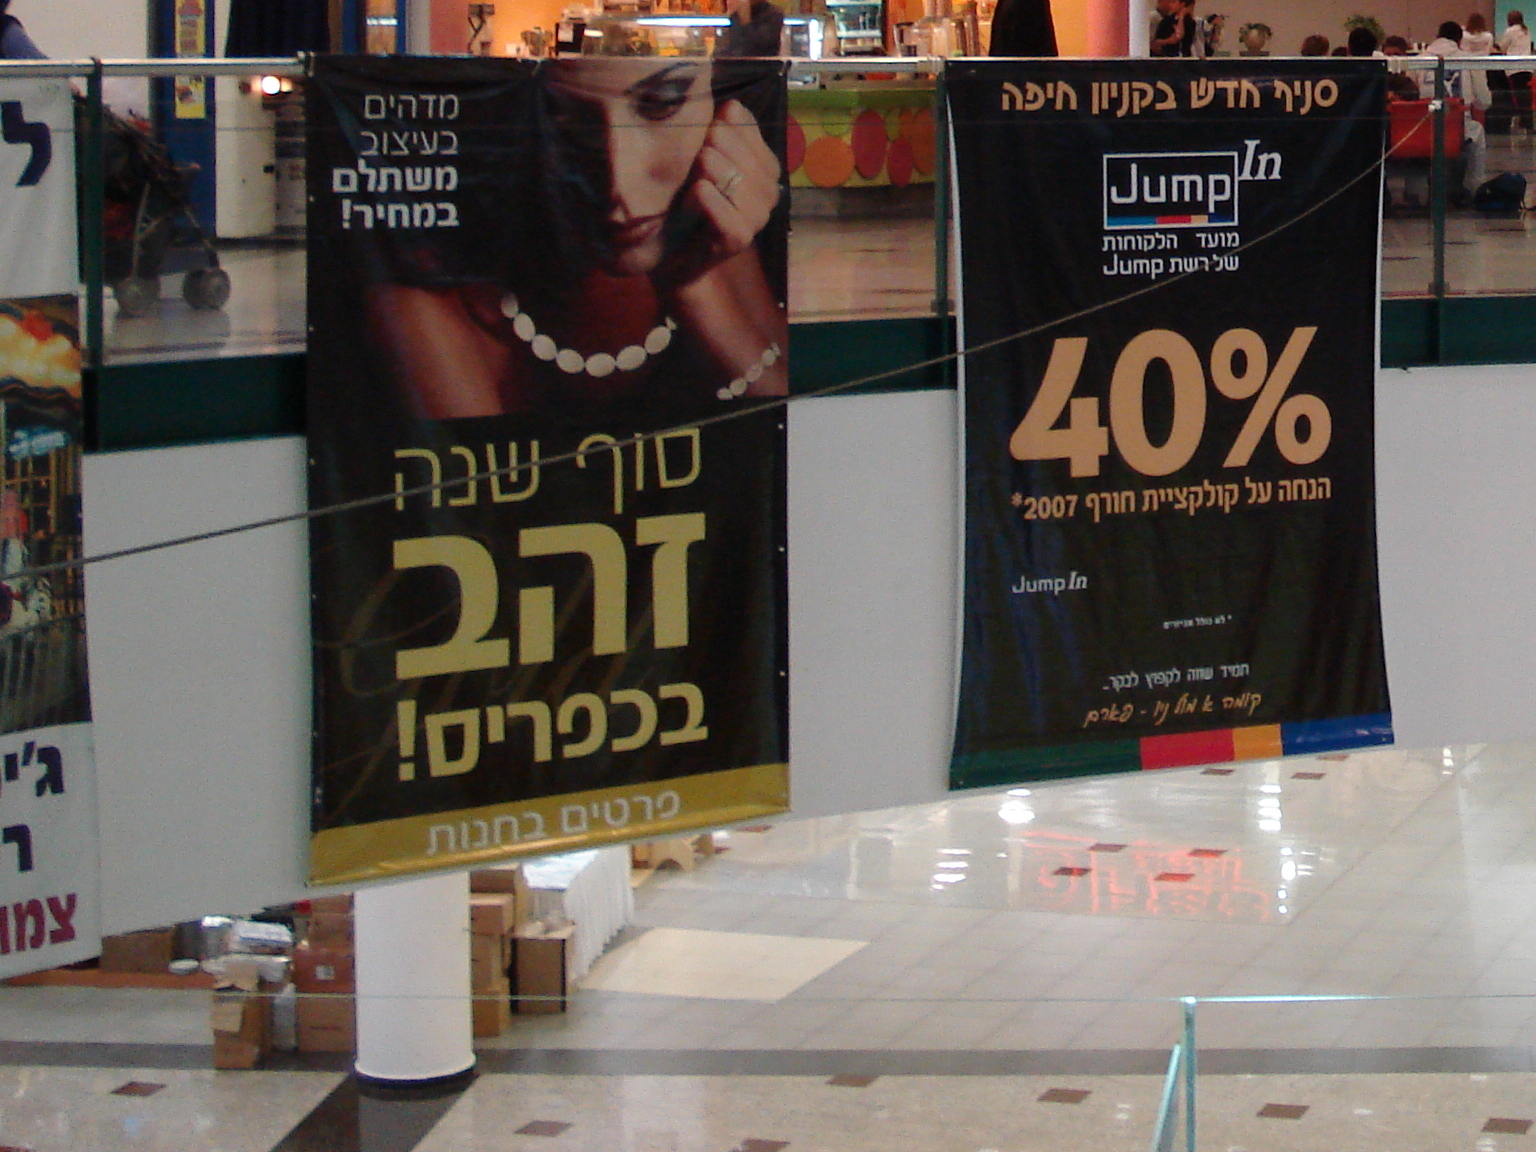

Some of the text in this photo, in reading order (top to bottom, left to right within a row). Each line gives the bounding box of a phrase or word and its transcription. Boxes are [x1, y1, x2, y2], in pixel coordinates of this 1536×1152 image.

[364, 92, 460, 120] מדהים
[1001, 77, 1339, 118] סניף חדש בקניון חיפה
[360, 130, 459, 158] בעיצוב
[332, 160, 459, 194] משתלם
[1110, 139, 1283, 213] Jump In
[341, 201, 460, 230] במחיר!
[1102, 231, 1240, 252] מועד הלקוחות
[1103, 253, 1239, 280] של רשת Jump
[1009, 325, 1333, 479] 40%
[394, 426, 700, 515] סוף שנה
[1084, 490, 1137, 524] חורף
[1141, 479, 1240, 517] קולקציית
[1245, 476, 1273, 504] על
[1278, 477, 1332, 503] הנחה
[393, 512, 706, 680] זהב
[426, 789, 682, 856] פרטים בחנות
